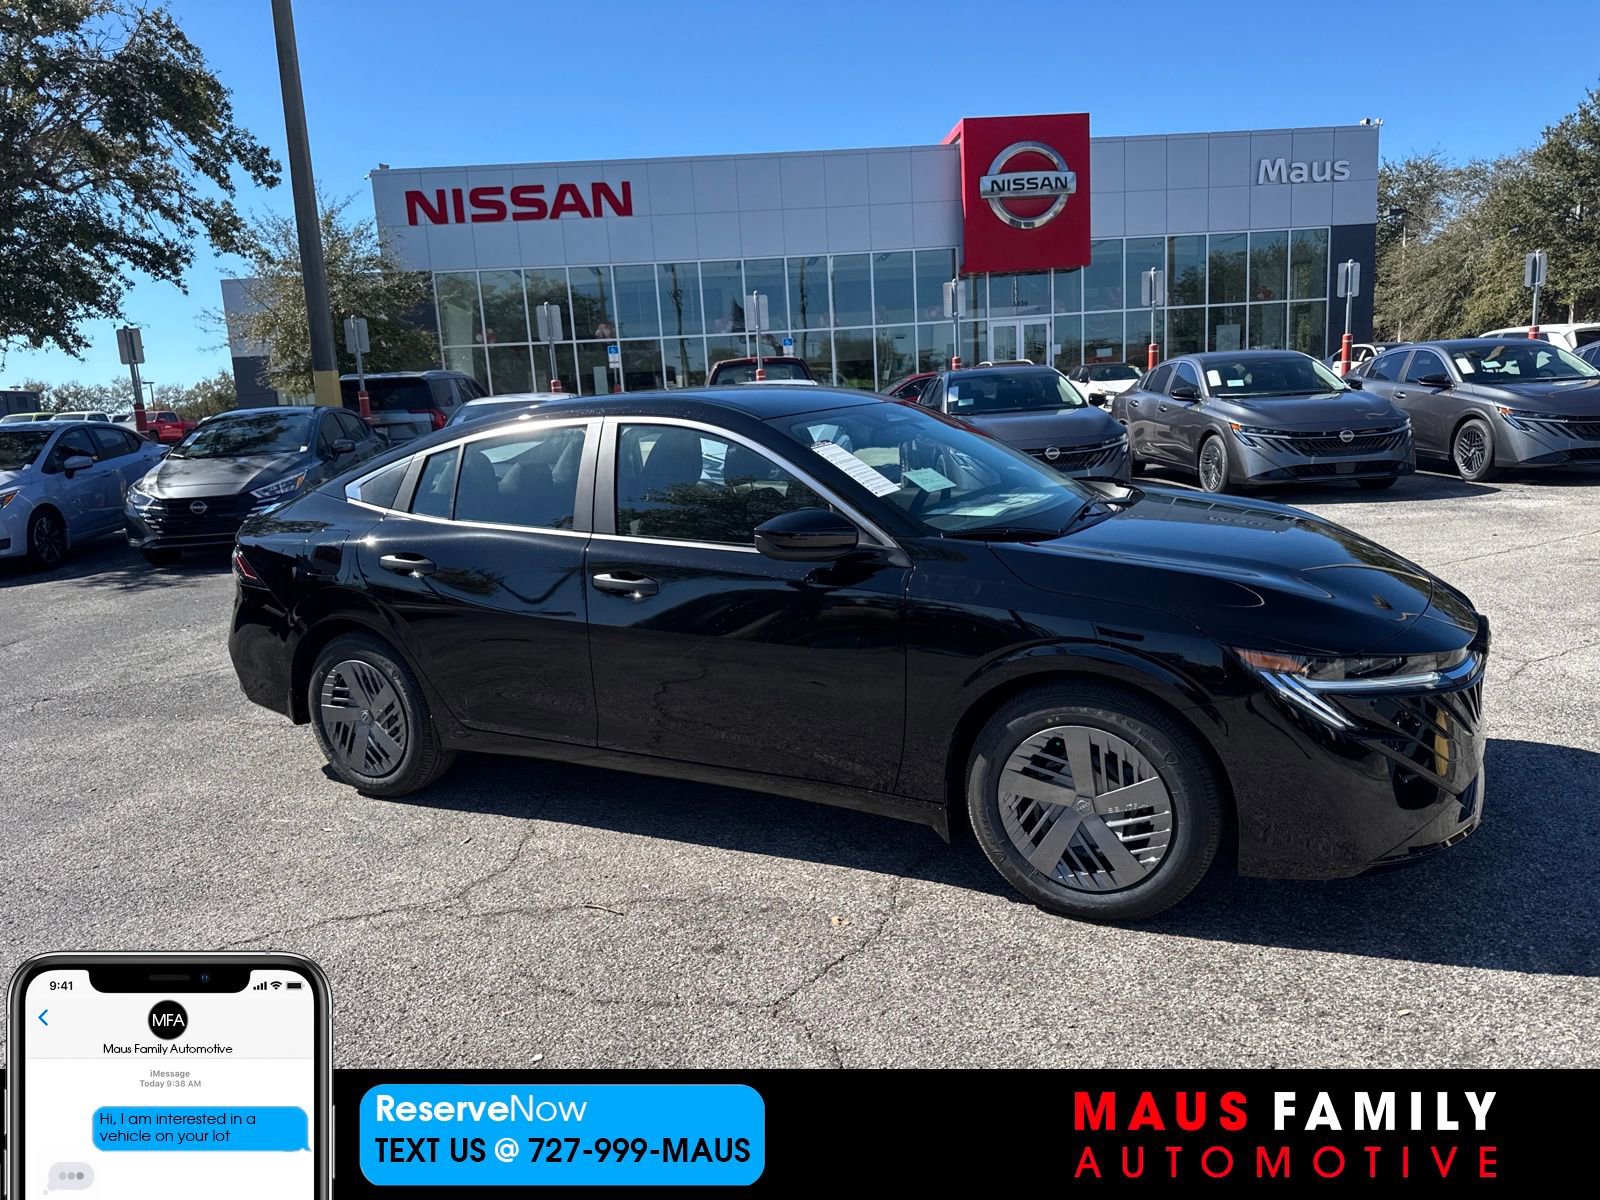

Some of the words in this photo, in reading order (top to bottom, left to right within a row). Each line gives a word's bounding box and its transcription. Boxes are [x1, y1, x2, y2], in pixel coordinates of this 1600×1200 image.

[990, 176, 1067, 193] NISSAN
[1257, 158, 1351, 185] Maus
[405, 181, 633, 226] NISSAN
